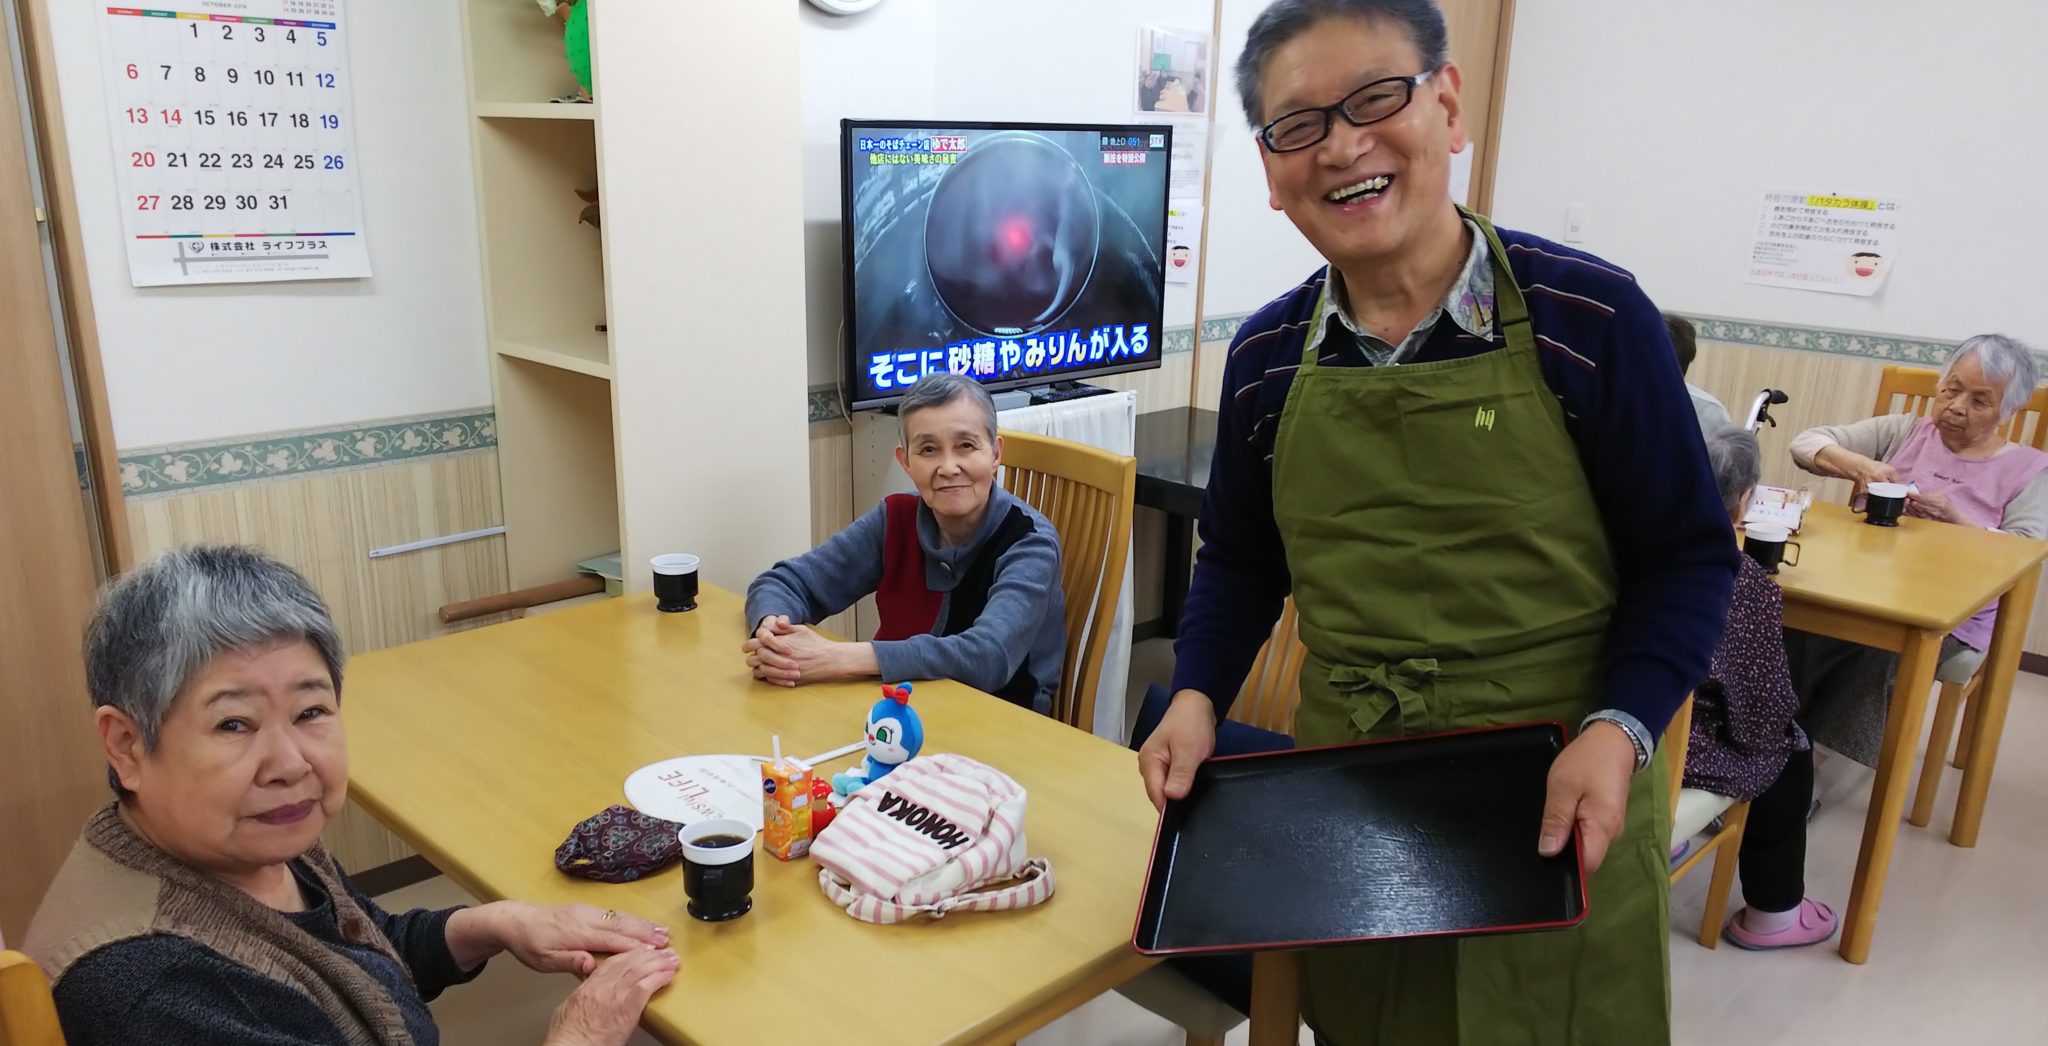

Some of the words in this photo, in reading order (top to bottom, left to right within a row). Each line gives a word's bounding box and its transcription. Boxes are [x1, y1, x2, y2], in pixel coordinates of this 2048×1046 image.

[189, 22, 198, 38] 1
[222, 25, 234, 40] 2
[254, 27, 265, 43] 3
[286, 29, 297, 44] 4
[317, 31, 327, 46] 5
[127, 63, 139, 79] 6
[160, 65, 172, 80] 7
[194, 66, 206, 82] 8
[227, 68, 238, 83] 9
[254, 70, 275, 85] 10
[286, 71, 304, 87] 11
[315, 73, 335, 88] 12
[126, 107, 149, 124] 13
[160, 109, 182, 124] 14
[194, 110, 215, 125] 15
[226, 111, 248, 126] 16
[259, 112, 278, 127] 17
[289, 113, 310, 128] 18
[319, 114, 339, 129] 19
[860, 139, 930, 151] 日本一のそばチェーン店
[932, 138, 966, 151] ゆで太郎
[131, 152, 156, 168] 20
[167, 152, 188, 168] 21
[199, 153, 222, 168] 22
[231, 153, 254, 168] 23
[263, 154, 285, 169] 24
[293, 154, 315, 169] 25
[323, 155, 344, 170] 26
[137, 195, 161, 210] 27
[171, 195, 194, 210] 28
[204, 195, 226, 210] 29
[235, 195, 258, 210] 30
[269, 195, 288, 210] 31
[210, 241, 256, 251] 株式会社
[262, 240, 328, 250] ライフプラス
[868, 324, 1149, 388] そこに砂糖やみりんが入る
[658, 770, 710, 798] LIFE
[877, 791, 970, 850] HONOKA
